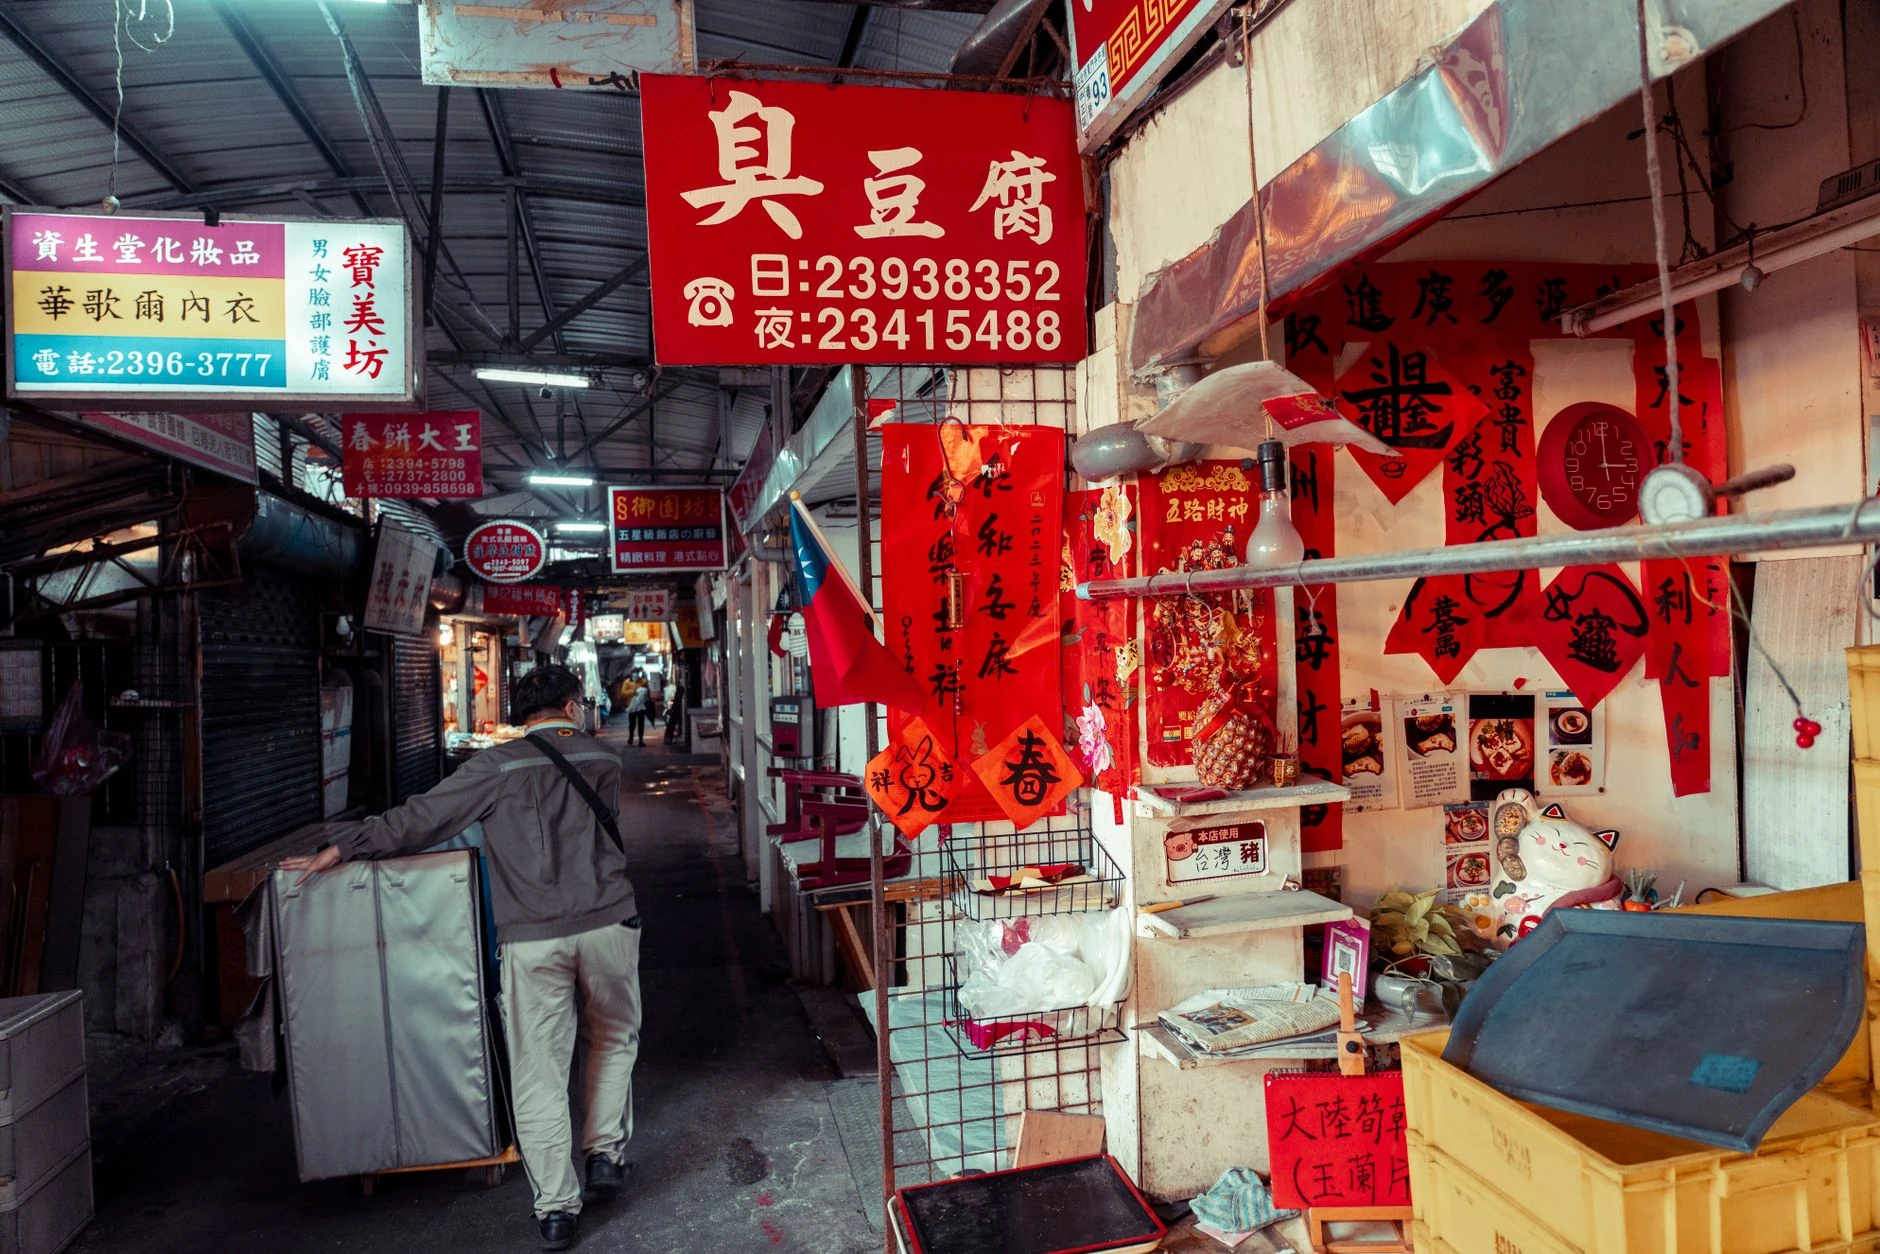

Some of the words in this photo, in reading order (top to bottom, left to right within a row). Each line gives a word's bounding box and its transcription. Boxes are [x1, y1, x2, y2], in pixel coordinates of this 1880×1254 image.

[1092, 72, 1107, 107] 93
[680, 90, 1057, 246] 臭豆腐
[32, 230, 260, 266] 資生堂化妝品
[750, 253, 1061, 301] 日:23938352
[37, 285, 261, 322] 華歌爾內衣
[309, 238, 331, 381] 男女臉部護膚
[343, 243, 389, 379] 寶美坊
[754, 306, 1062, 351] 夜:23415488
[32, 348, 272, 378] 電話:2396-3777
[1489, 360, 1528, 458] 富貴
[348, 421, 478, 452] 春餅大王
[1578, 429, 1591, 443] 11
[1592, 422, 1608, 436] 12
[1569, 440, 1586, 455] 10
[1621, 441, 1632, 455] 2
[1566, 458, 1579, 472] 9
[1624, 458, 1638, 472] 3
[1570, 475, 1584, 491] 8
[1585, 487, 1597, 503] 7
[1612, 486, 1627, 501] 5
[1621, 475, 1635, 490] 4
[1166, 497, 1249, 524] 五路財神
[1597, 495, 1611, 509] 6
[1000, 728, 1062, 806] 春
[871, 768, 895, 794] 祥
[1197, 827, 1239, 843] 本店使用
